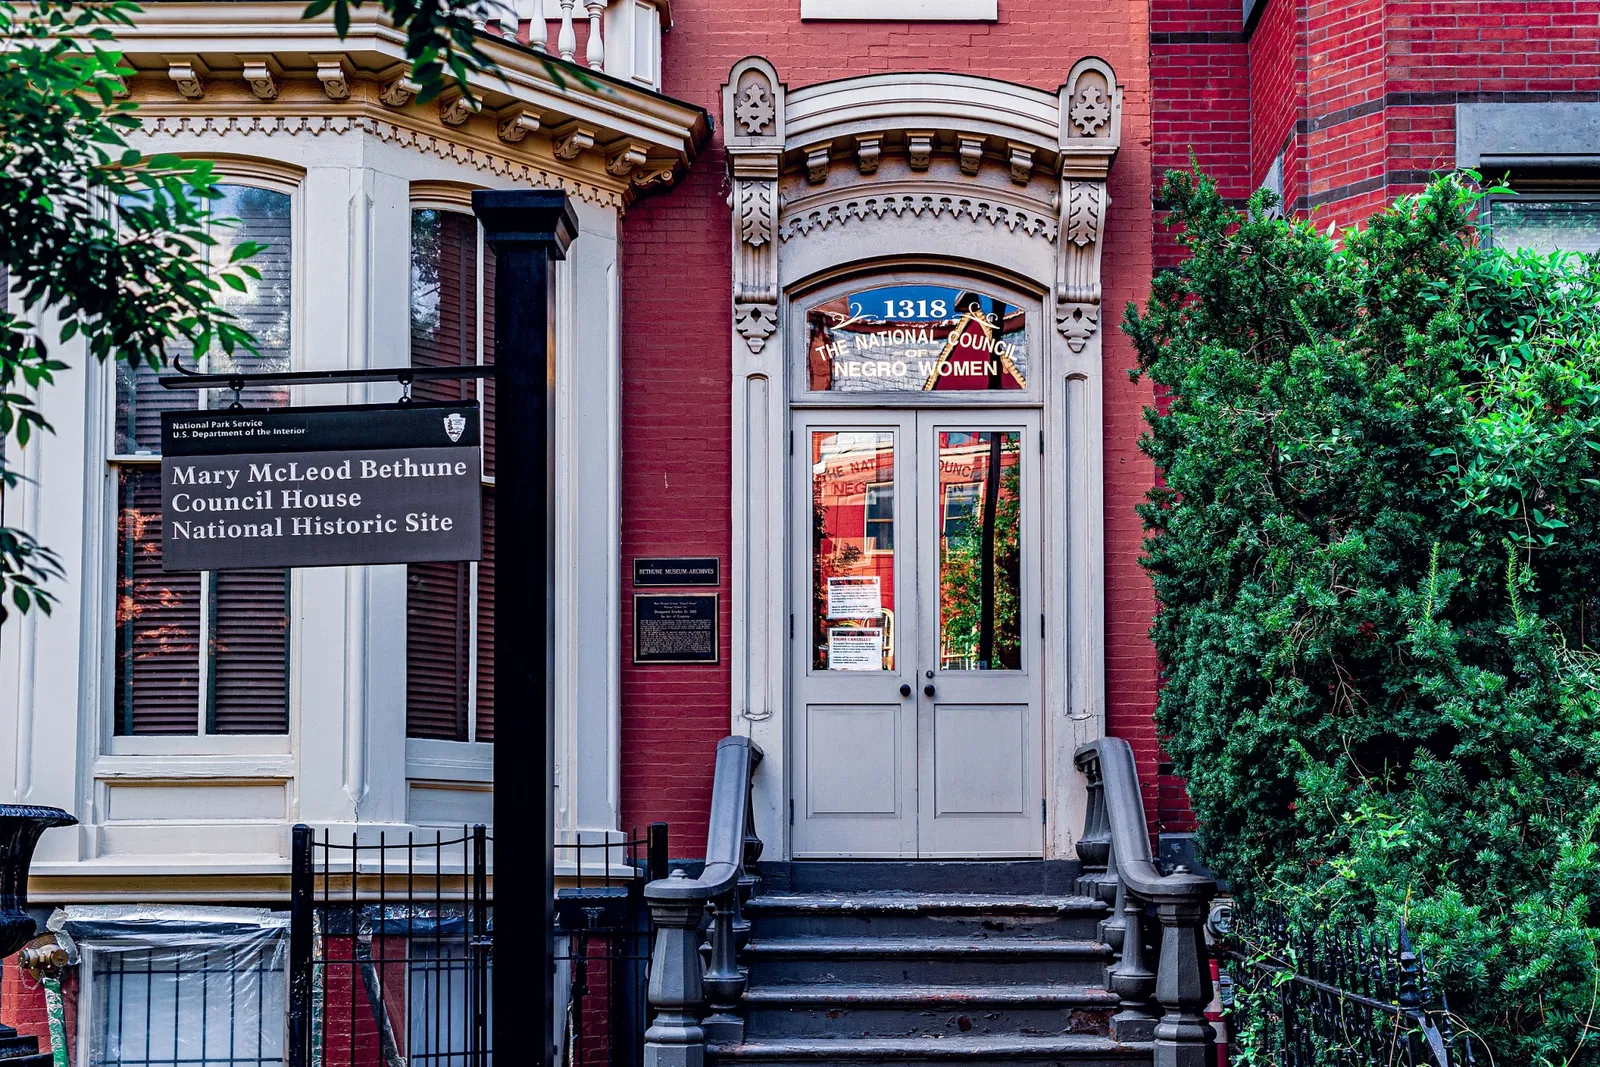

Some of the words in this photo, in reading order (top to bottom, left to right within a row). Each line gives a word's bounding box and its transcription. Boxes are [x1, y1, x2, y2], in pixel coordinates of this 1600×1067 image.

[884, 299, 947, 318] 1318
[815, 339, 849, 361] THE
[855, 329, 939, 351] NATIONAL
[948, 332, 1018, 361] COUNCIL
[905, 349, 926, 358] OF
[834, 362, 907, 377] NEGRO
[919, 361, 998, 376] WOMEN
[173, 421, 209, 429] National
[211, 420, 230, 428] Park
[232, 419, 263, 428] Service
[192, 429, 243, 438] Department
[273, 427, 306, 435] Interior
[171, 466, 240, 489] Mary
[248, 460, 351, 482] McLeod
[360, 458, 467, 478] Bethune
[171, 489, 272, 512] Council
[281, 489, 362, 509] House
[171, 517, 283, 540] National
[291, 514, 398, 536] Historic
[405, 513, 454, 532] Site
